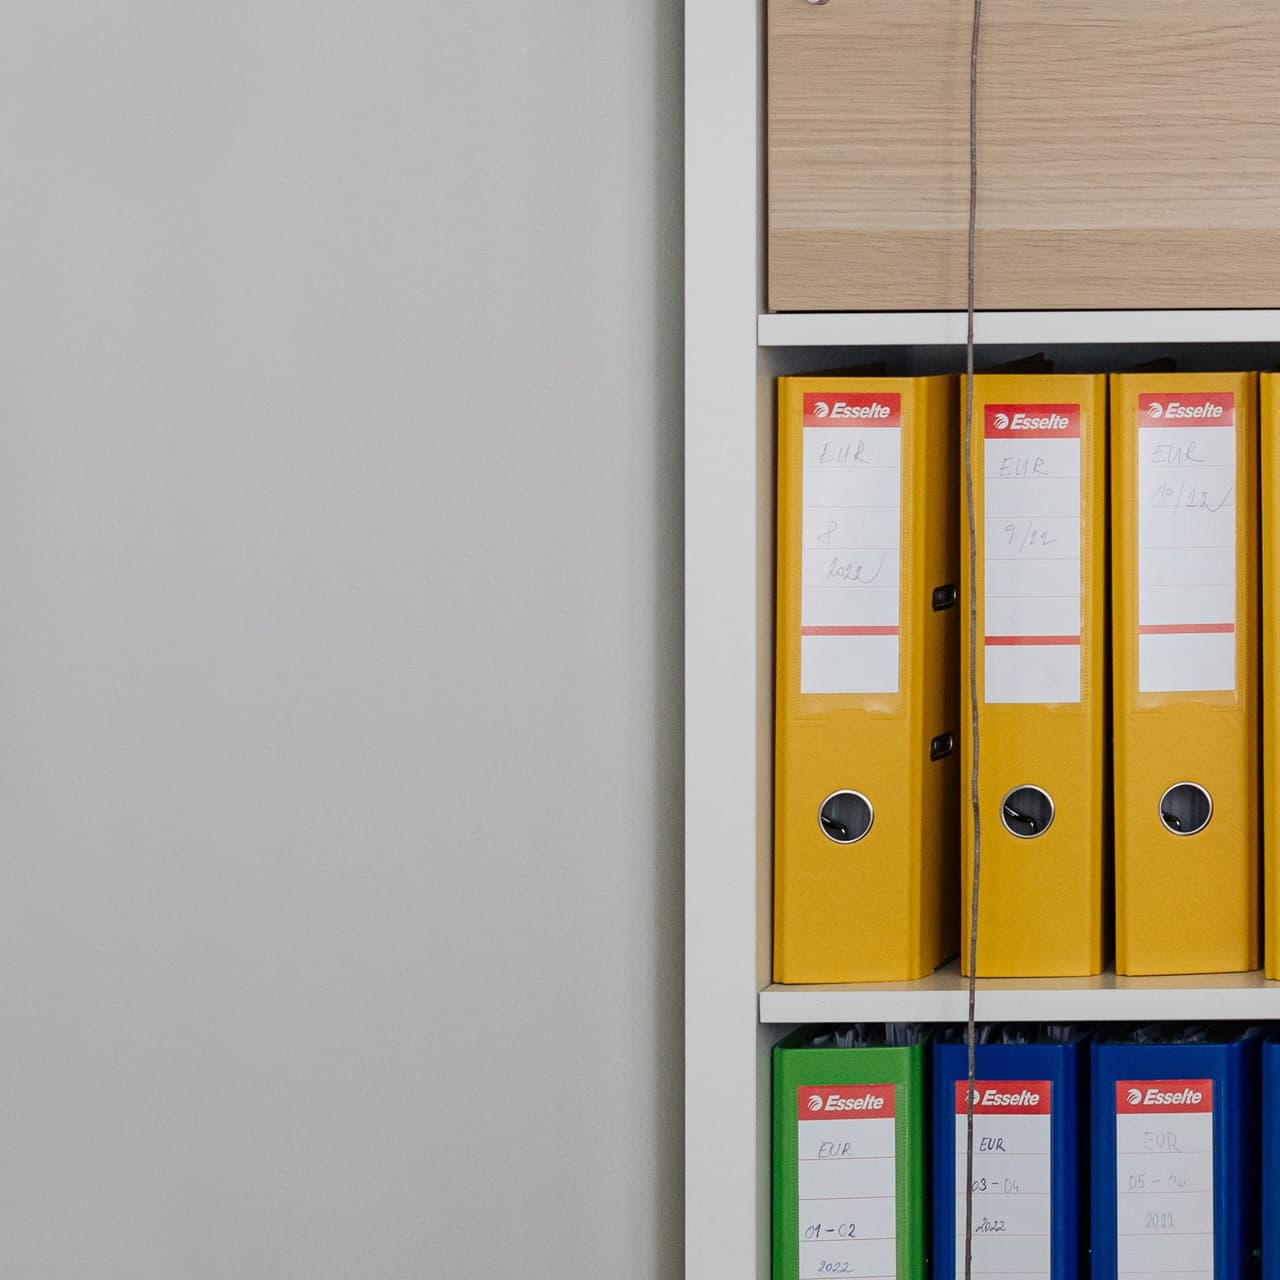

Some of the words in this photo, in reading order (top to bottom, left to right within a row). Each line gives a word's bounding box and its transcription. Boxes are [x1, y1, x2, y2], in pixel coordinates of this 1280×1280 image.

[831, 402, 890, 419] Esselte
[1164, 402, 1223, 419] Esselte
[1011, 413, 1069, 430] Esselte
[817, 440, 871, 465] EUR
[1151, 441, 1205, 465] EUR
[999, 457, 1048, 477] EUR
[816, 520, 838, 545] 8
[825, 1094, 884, 1112] Esselte
[982, 1089, 1040, 1106] Esselte
[1144, 1088, 1203, 1105] Esselte
[817, 1141, 851, 1159] EUR
[979, 1136, 1006, 1153] EUR
[1144, 1131, 1183, 1153] EUR
[971, 1177, 988, 1193] 03
[804, 1223, 820, 1240] 01
[838, 1223, 856, 1238] 02
[975, 1218, 1007, 1233] 2022
[817, 1260, 856, 1273] 2022
